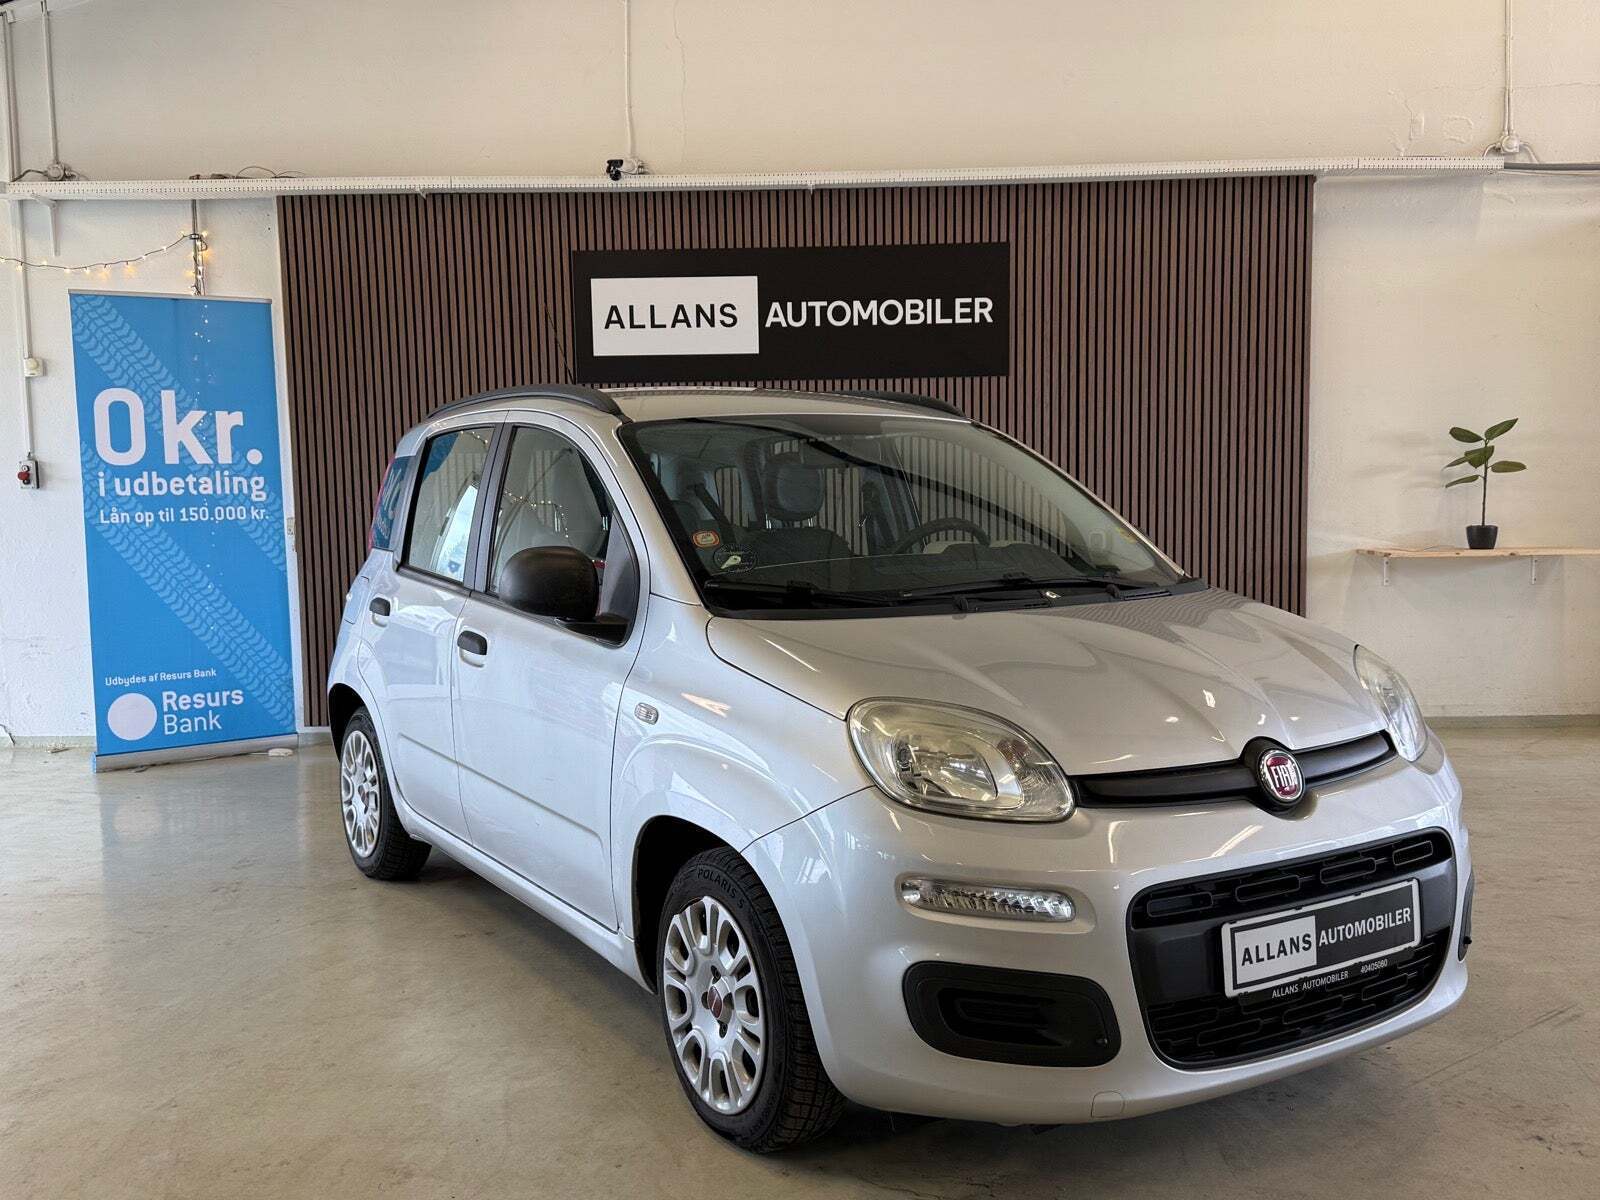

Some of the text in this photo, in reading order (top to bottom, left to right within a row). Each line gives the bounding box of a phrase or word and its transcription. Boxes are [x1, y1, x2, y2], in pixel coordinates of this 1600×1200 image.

[604, 297, 994, 330] ALLANS AUTOMOBILER
[93, 387, 264, 466] 0 kr.
[98, 470, 267, 502] i udbetaling
[100, 506, 269, 527] Lån op til 150.000 kr.
[105, 668, 217, 687] Udbydes af Resurs Bank
[162, 689, 244, 712] Resurs
[163, 710, 222, 735] Bank
[697, 868, 737, 898] POLARIS
[1241, 907, 1411, 966] ALLANS AUTOMOBILER
[1271, 984, 1299, 999] ALLANS
[1302, 971, 1349, 991] AUTOMOBILER
